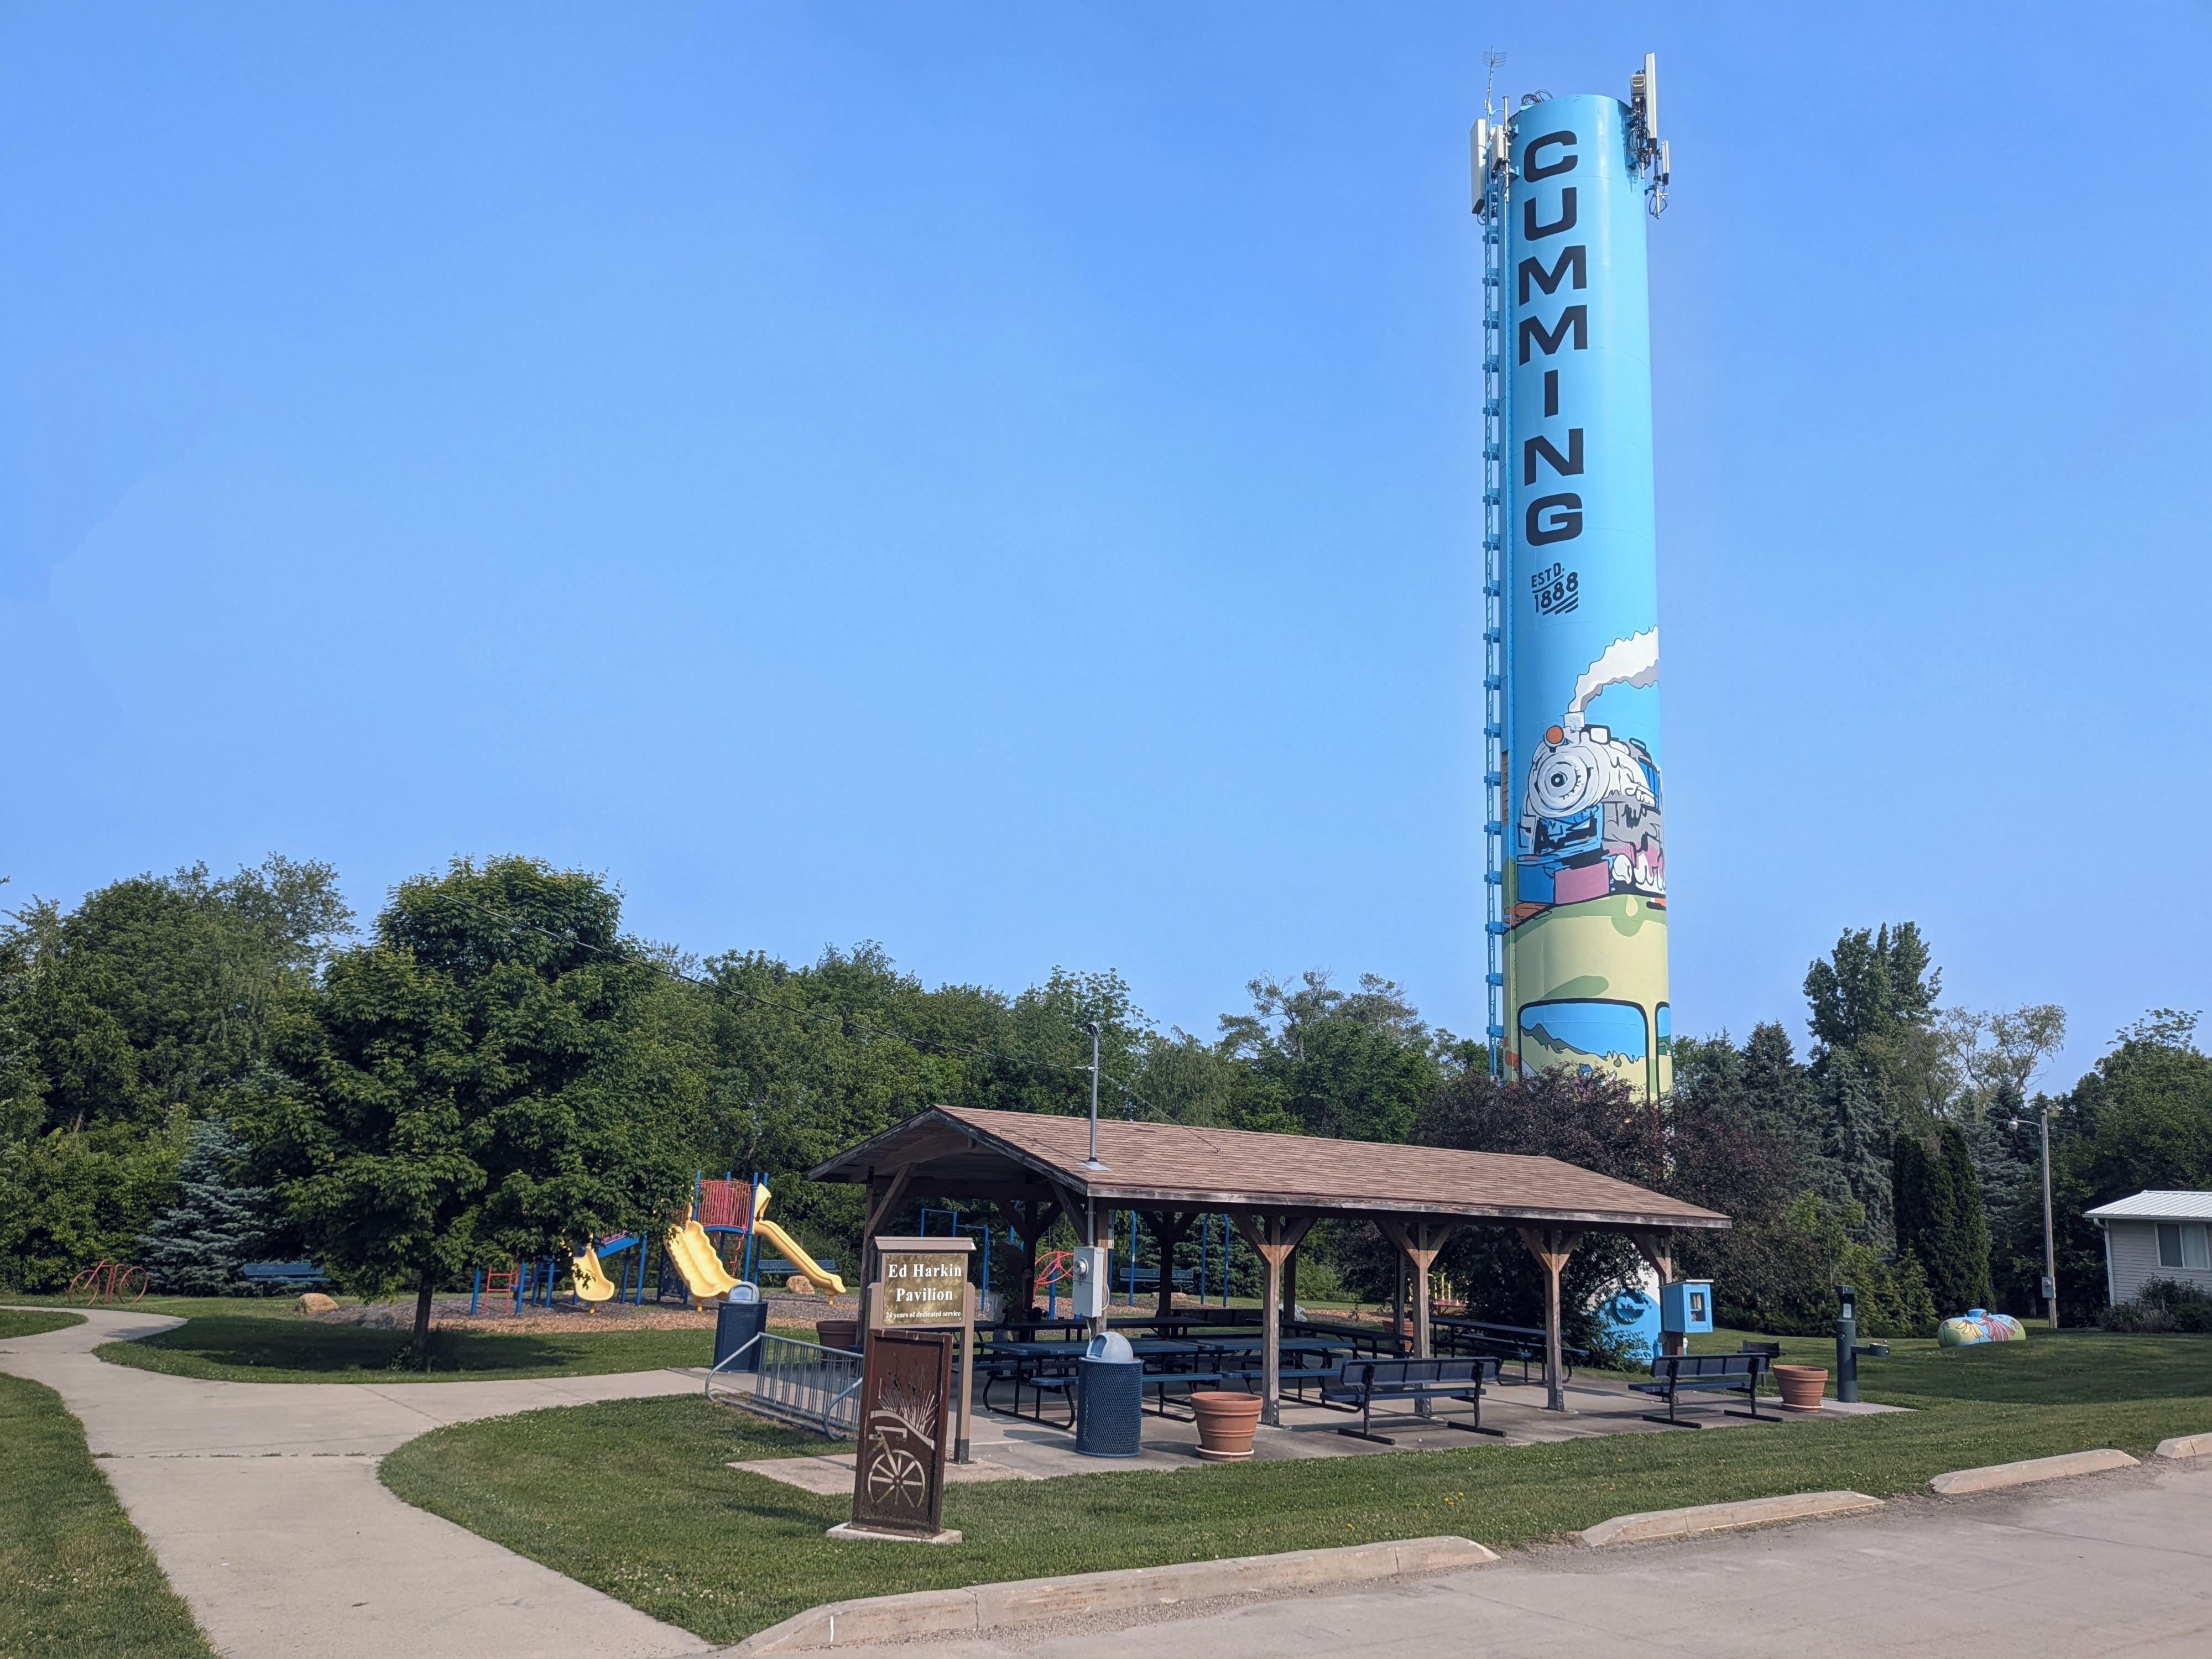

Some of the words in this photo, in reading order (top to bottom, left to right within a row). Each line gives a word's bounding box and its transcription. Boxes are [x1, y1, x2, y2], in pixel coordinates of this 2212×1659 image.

[1519, 130, 1588, 546] CUMMING
[1531, 562, 1565, 588] ESTD.
[1534, 571, 1579, 613] 1888
[888, 1264, 907, 1278] Ed
[913, 1263, 962, 1277] Harkin
[896, 1287, 953, 1302] Pavilion
